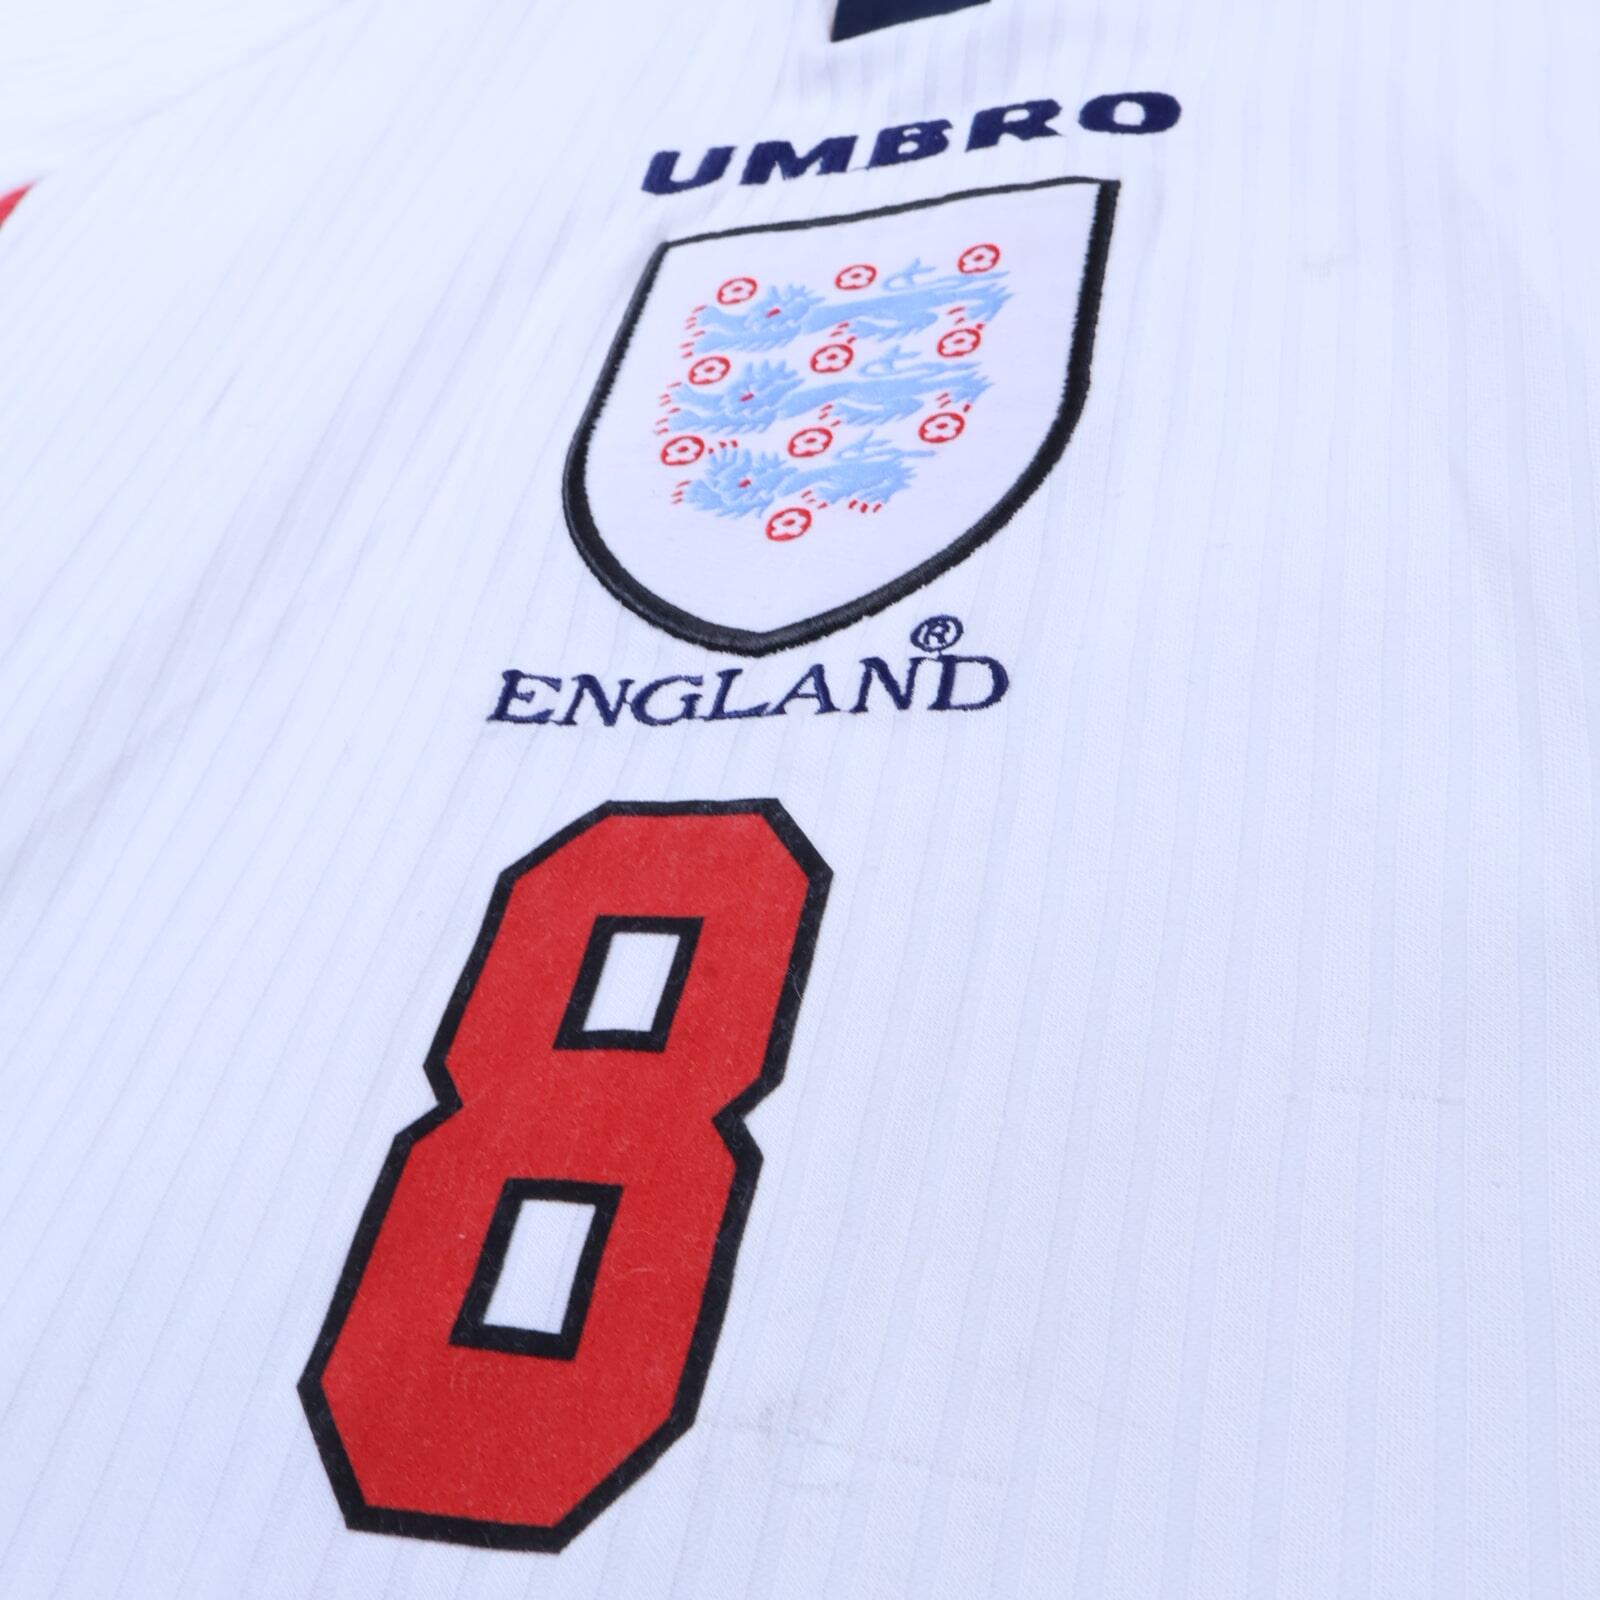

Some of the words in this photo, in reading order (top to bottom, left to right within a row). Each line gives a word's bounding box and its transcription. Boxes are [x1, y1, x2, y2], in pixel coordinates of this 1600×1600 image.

[641, 91, 1182, 196] UMBRO
[486, 655, 1010, 727] ENGLAND
[297, 798, 834, 1554] 8
